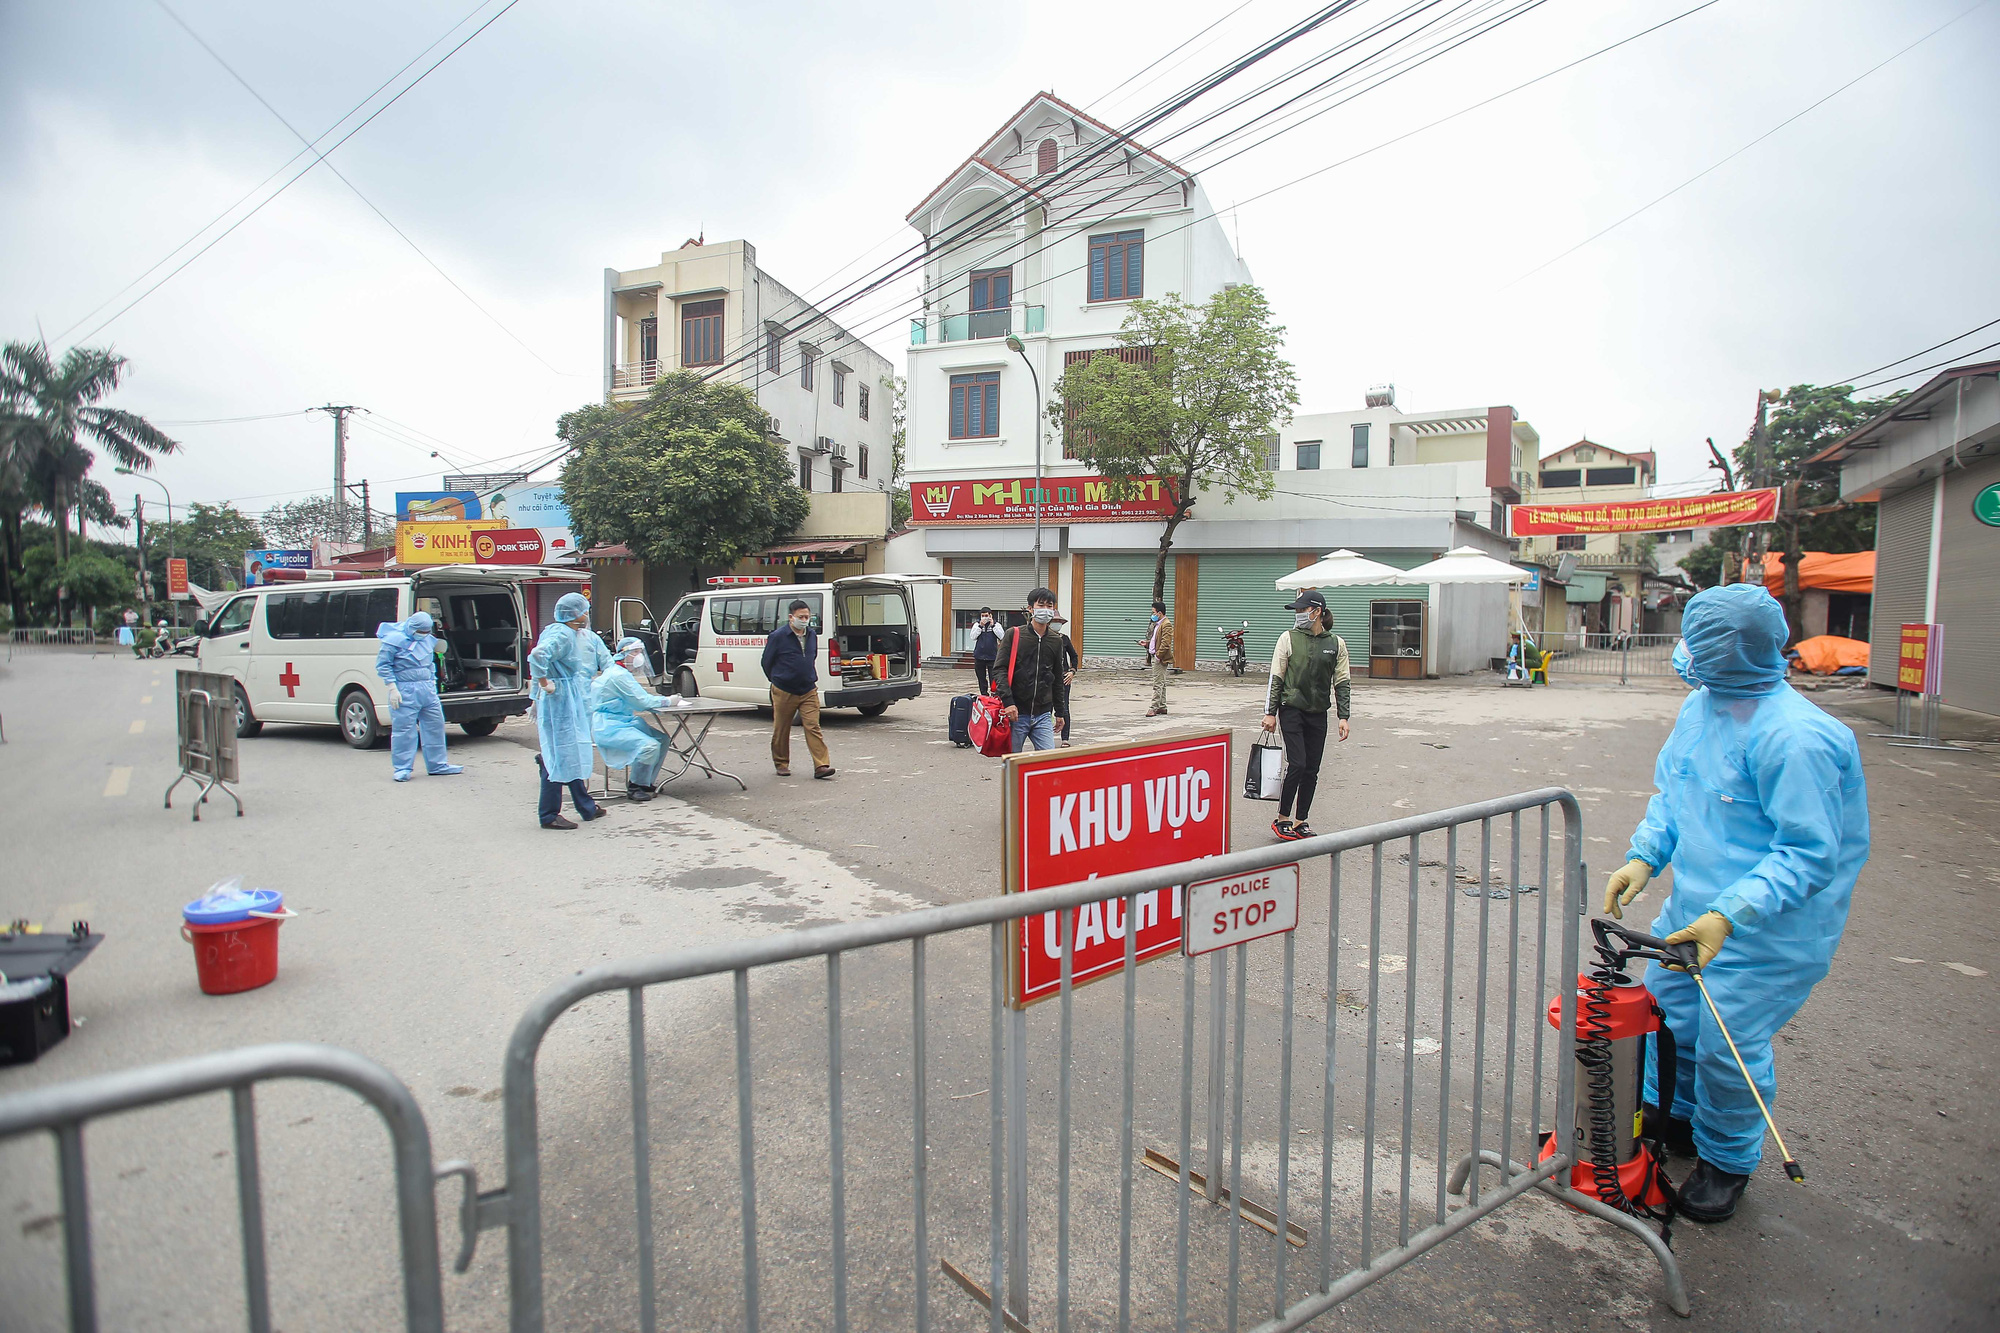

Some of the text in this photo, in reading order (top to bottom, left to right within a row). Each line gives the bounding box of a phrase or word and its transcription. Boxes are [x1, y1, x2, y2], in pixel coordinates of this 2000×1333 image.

[1029, 504, 1045, 512] Đn
[1067, 504, 1082, 512] Mọi
[1560, 509, 1582, 523] CÔNG
[1584, 510, 1594, 522] TU
[1611, 507, 1627, 521] TÔN
[1629, 508, 1645, 523] TẠO
[480, 542, 492, 552] CP
[497, 544, 518, 552] PORK
[519, 543, 540, 551] SHOP
[273, 553, 309, 567] Fujicolor
[1050, 766, 1211, 857] KHU VỰC
[1222, 877, 1270, 898] POLICE
[1213, 900, 1277, 935] STOP
